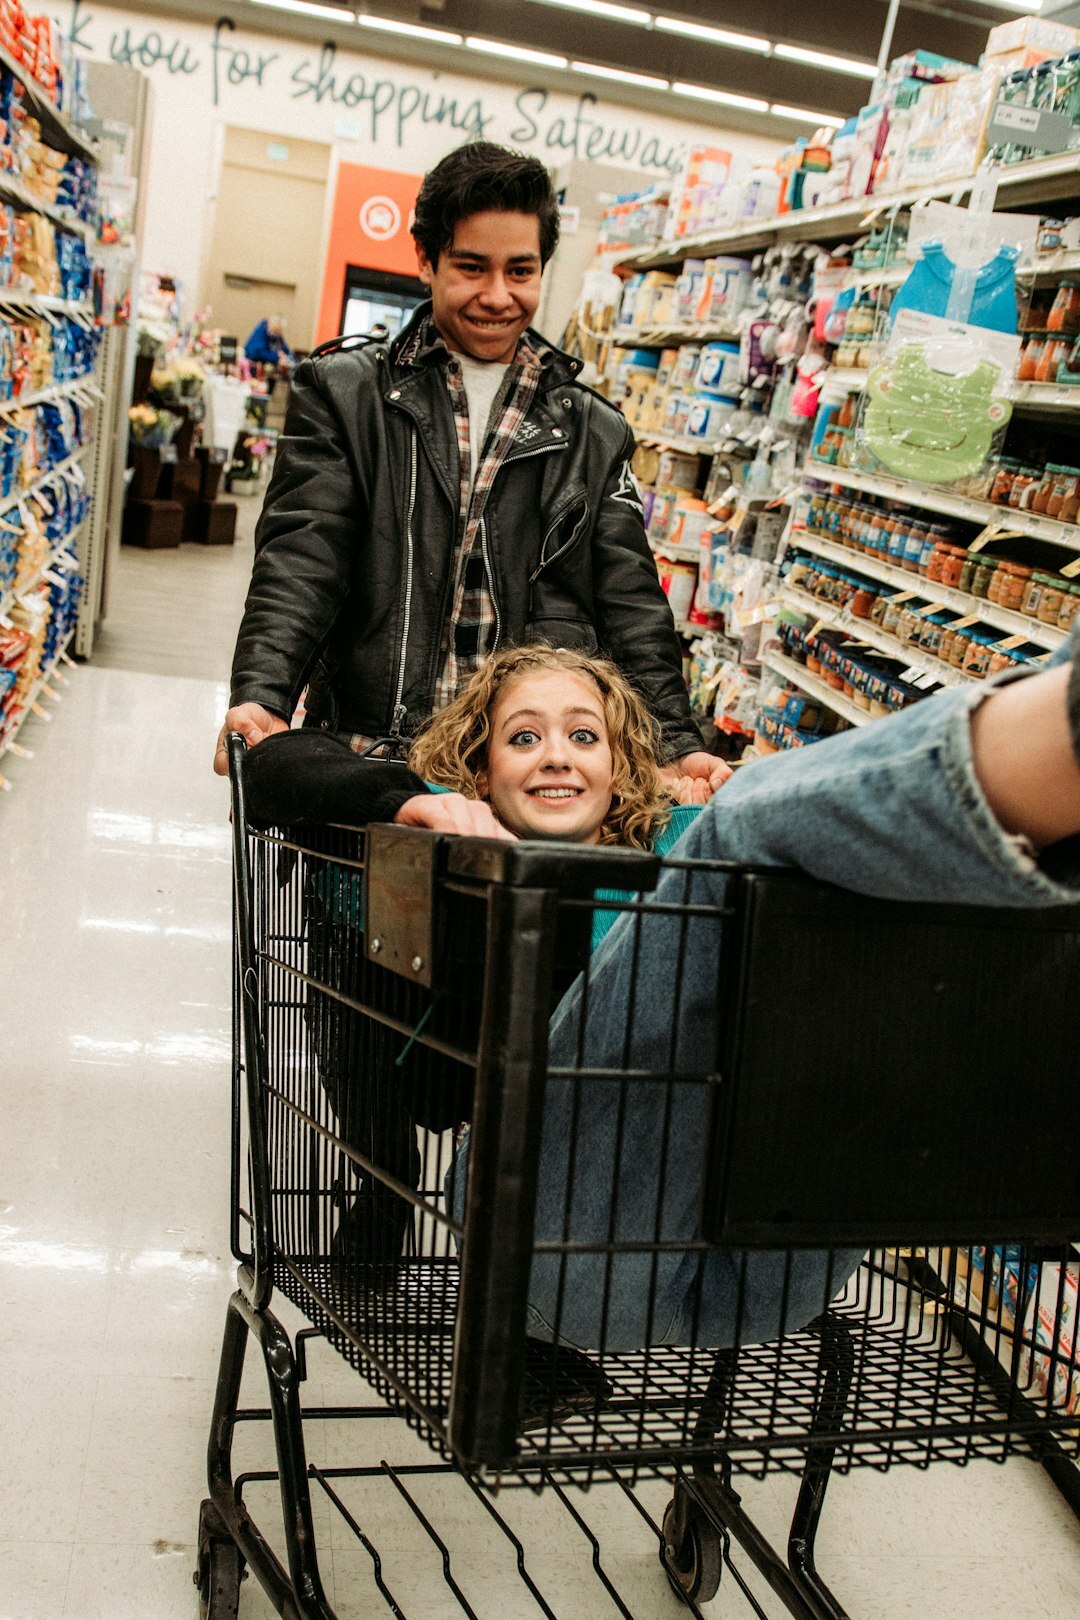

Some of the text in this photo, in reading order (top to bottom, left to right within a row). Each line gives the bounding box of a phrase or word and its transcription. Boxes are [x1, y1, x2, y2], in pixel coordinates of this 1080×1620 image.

[110, 28, 200, 74] you
[211, 16, 281, 106] for
[289, 39, 494, 146] shopping
